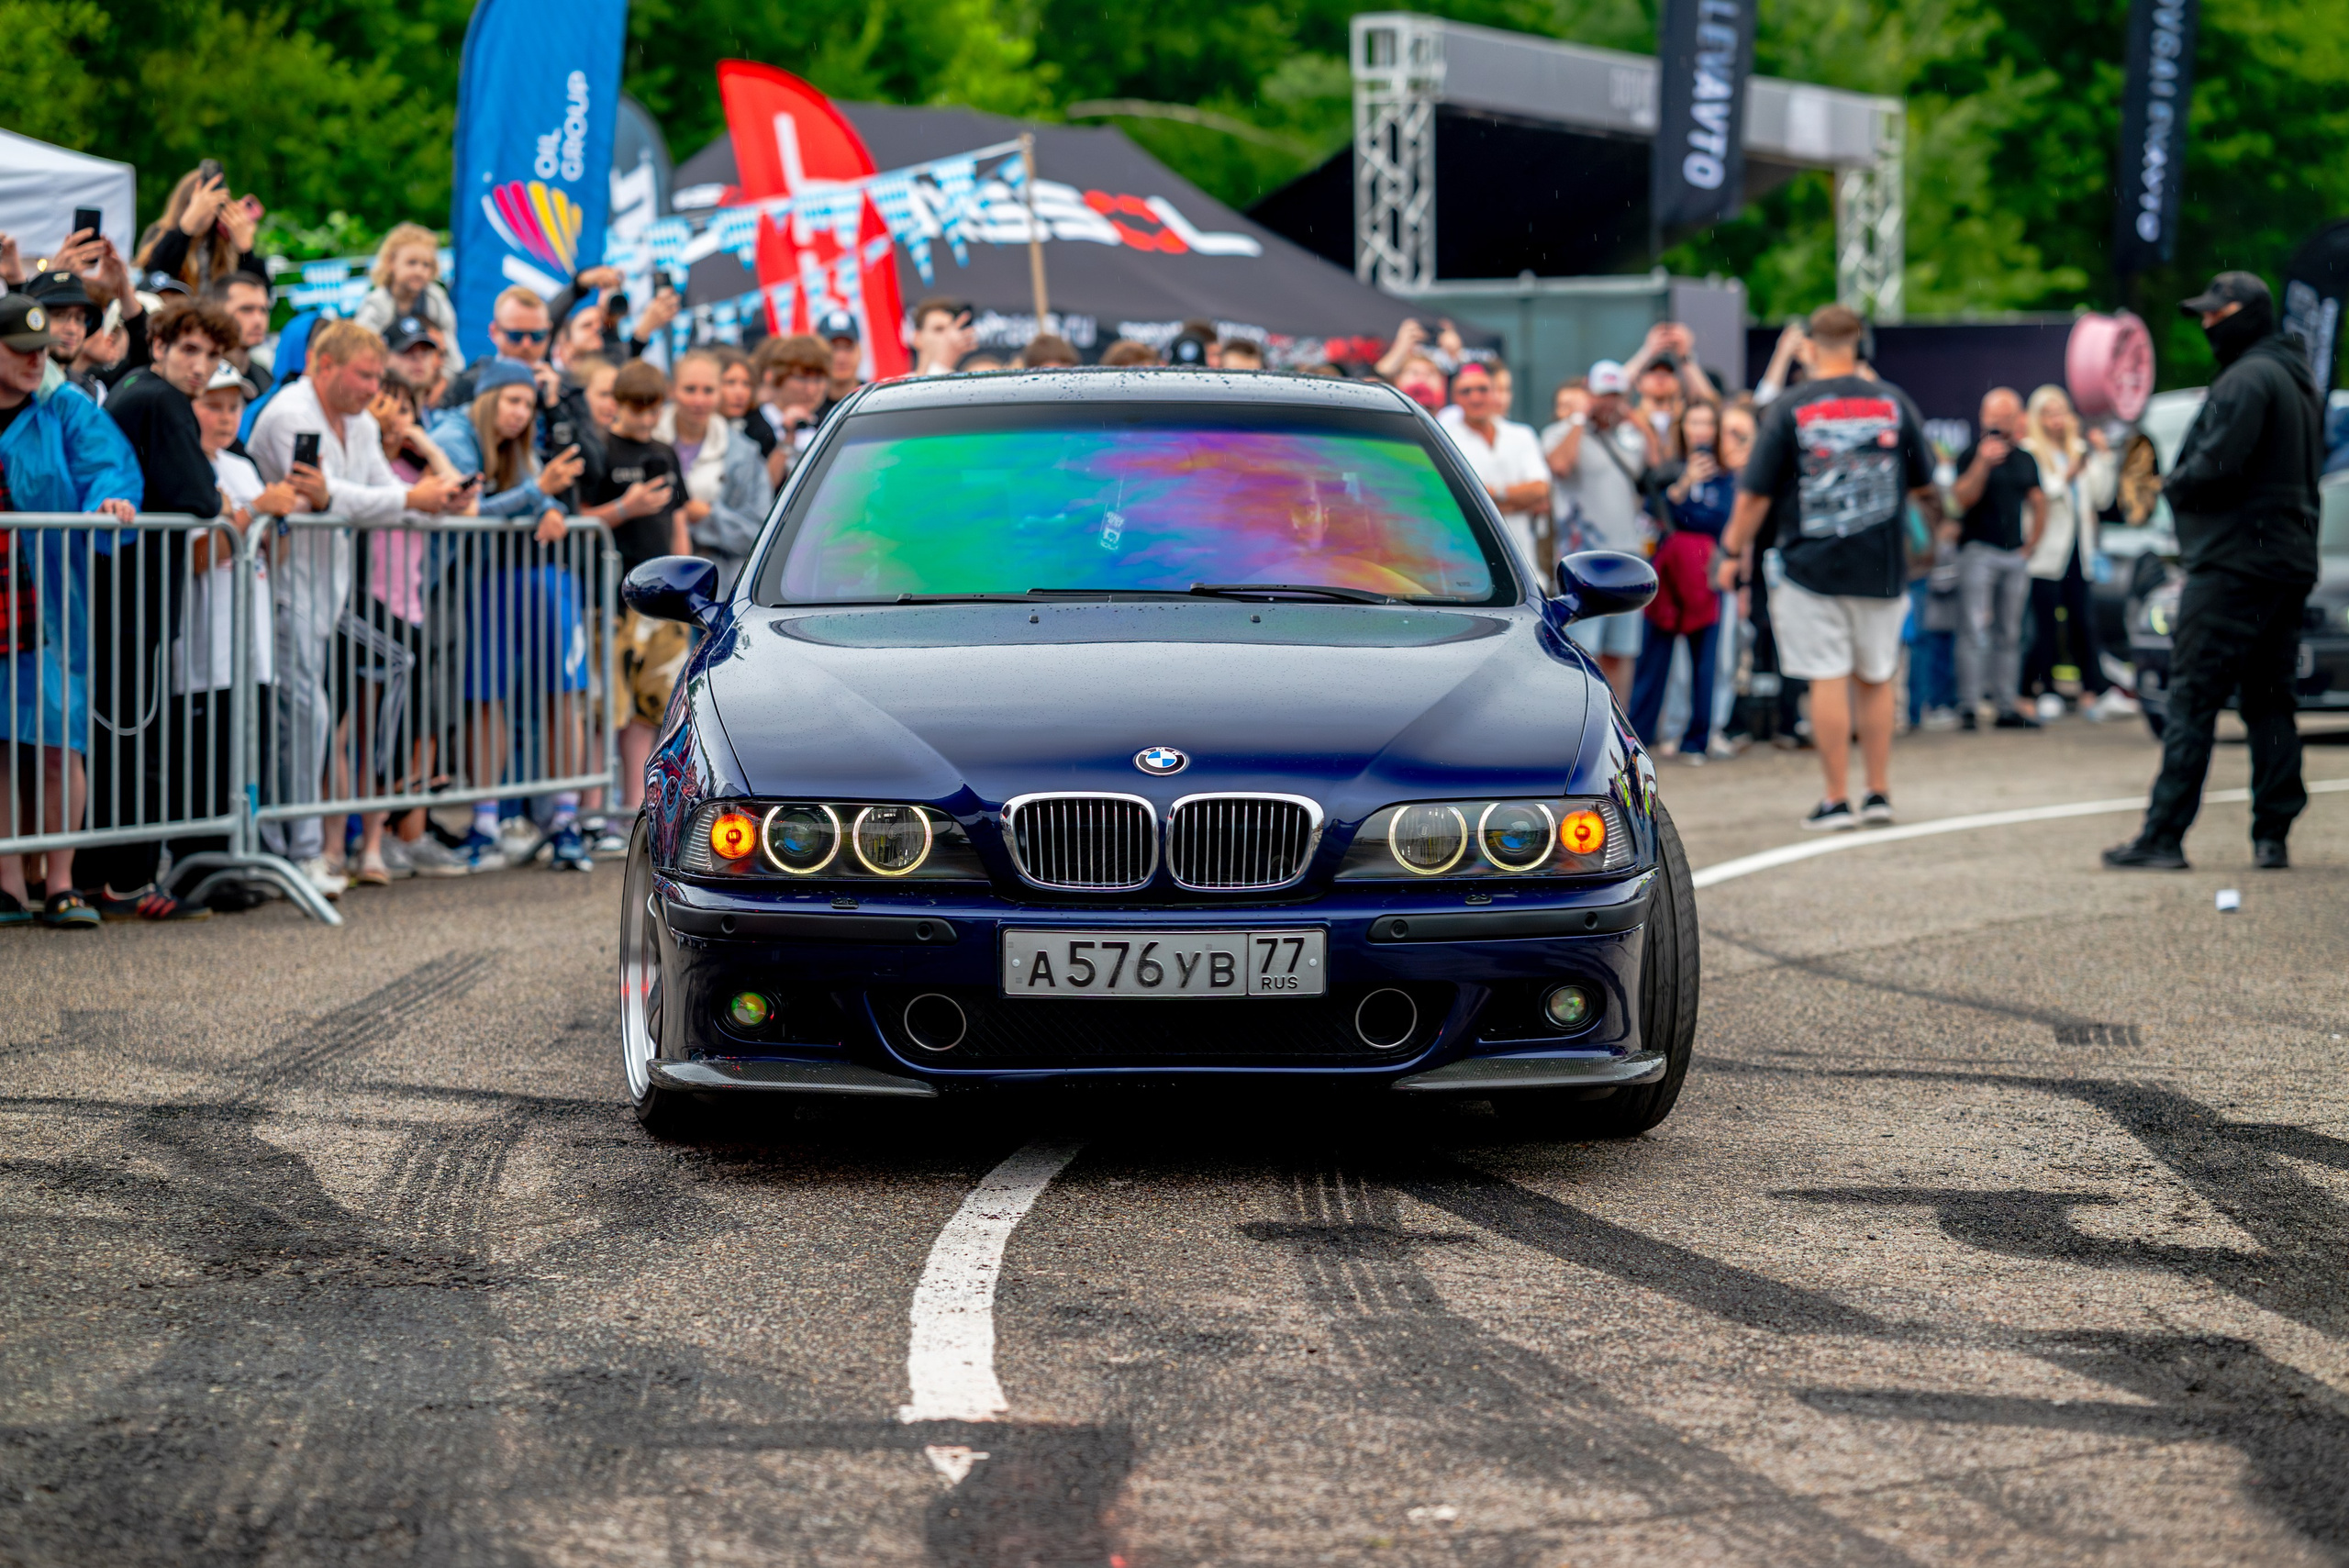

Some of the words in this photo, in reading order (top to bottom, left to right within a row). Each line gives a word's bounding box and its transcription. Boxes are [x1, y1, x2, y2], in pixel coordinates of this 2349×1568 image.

[561, 70, 589, 182] GROUP
[535, 127, 562, 180] OIL
[1256, 937, 1305, 973] 77
[1261, 975, 1299, 990] RUS
